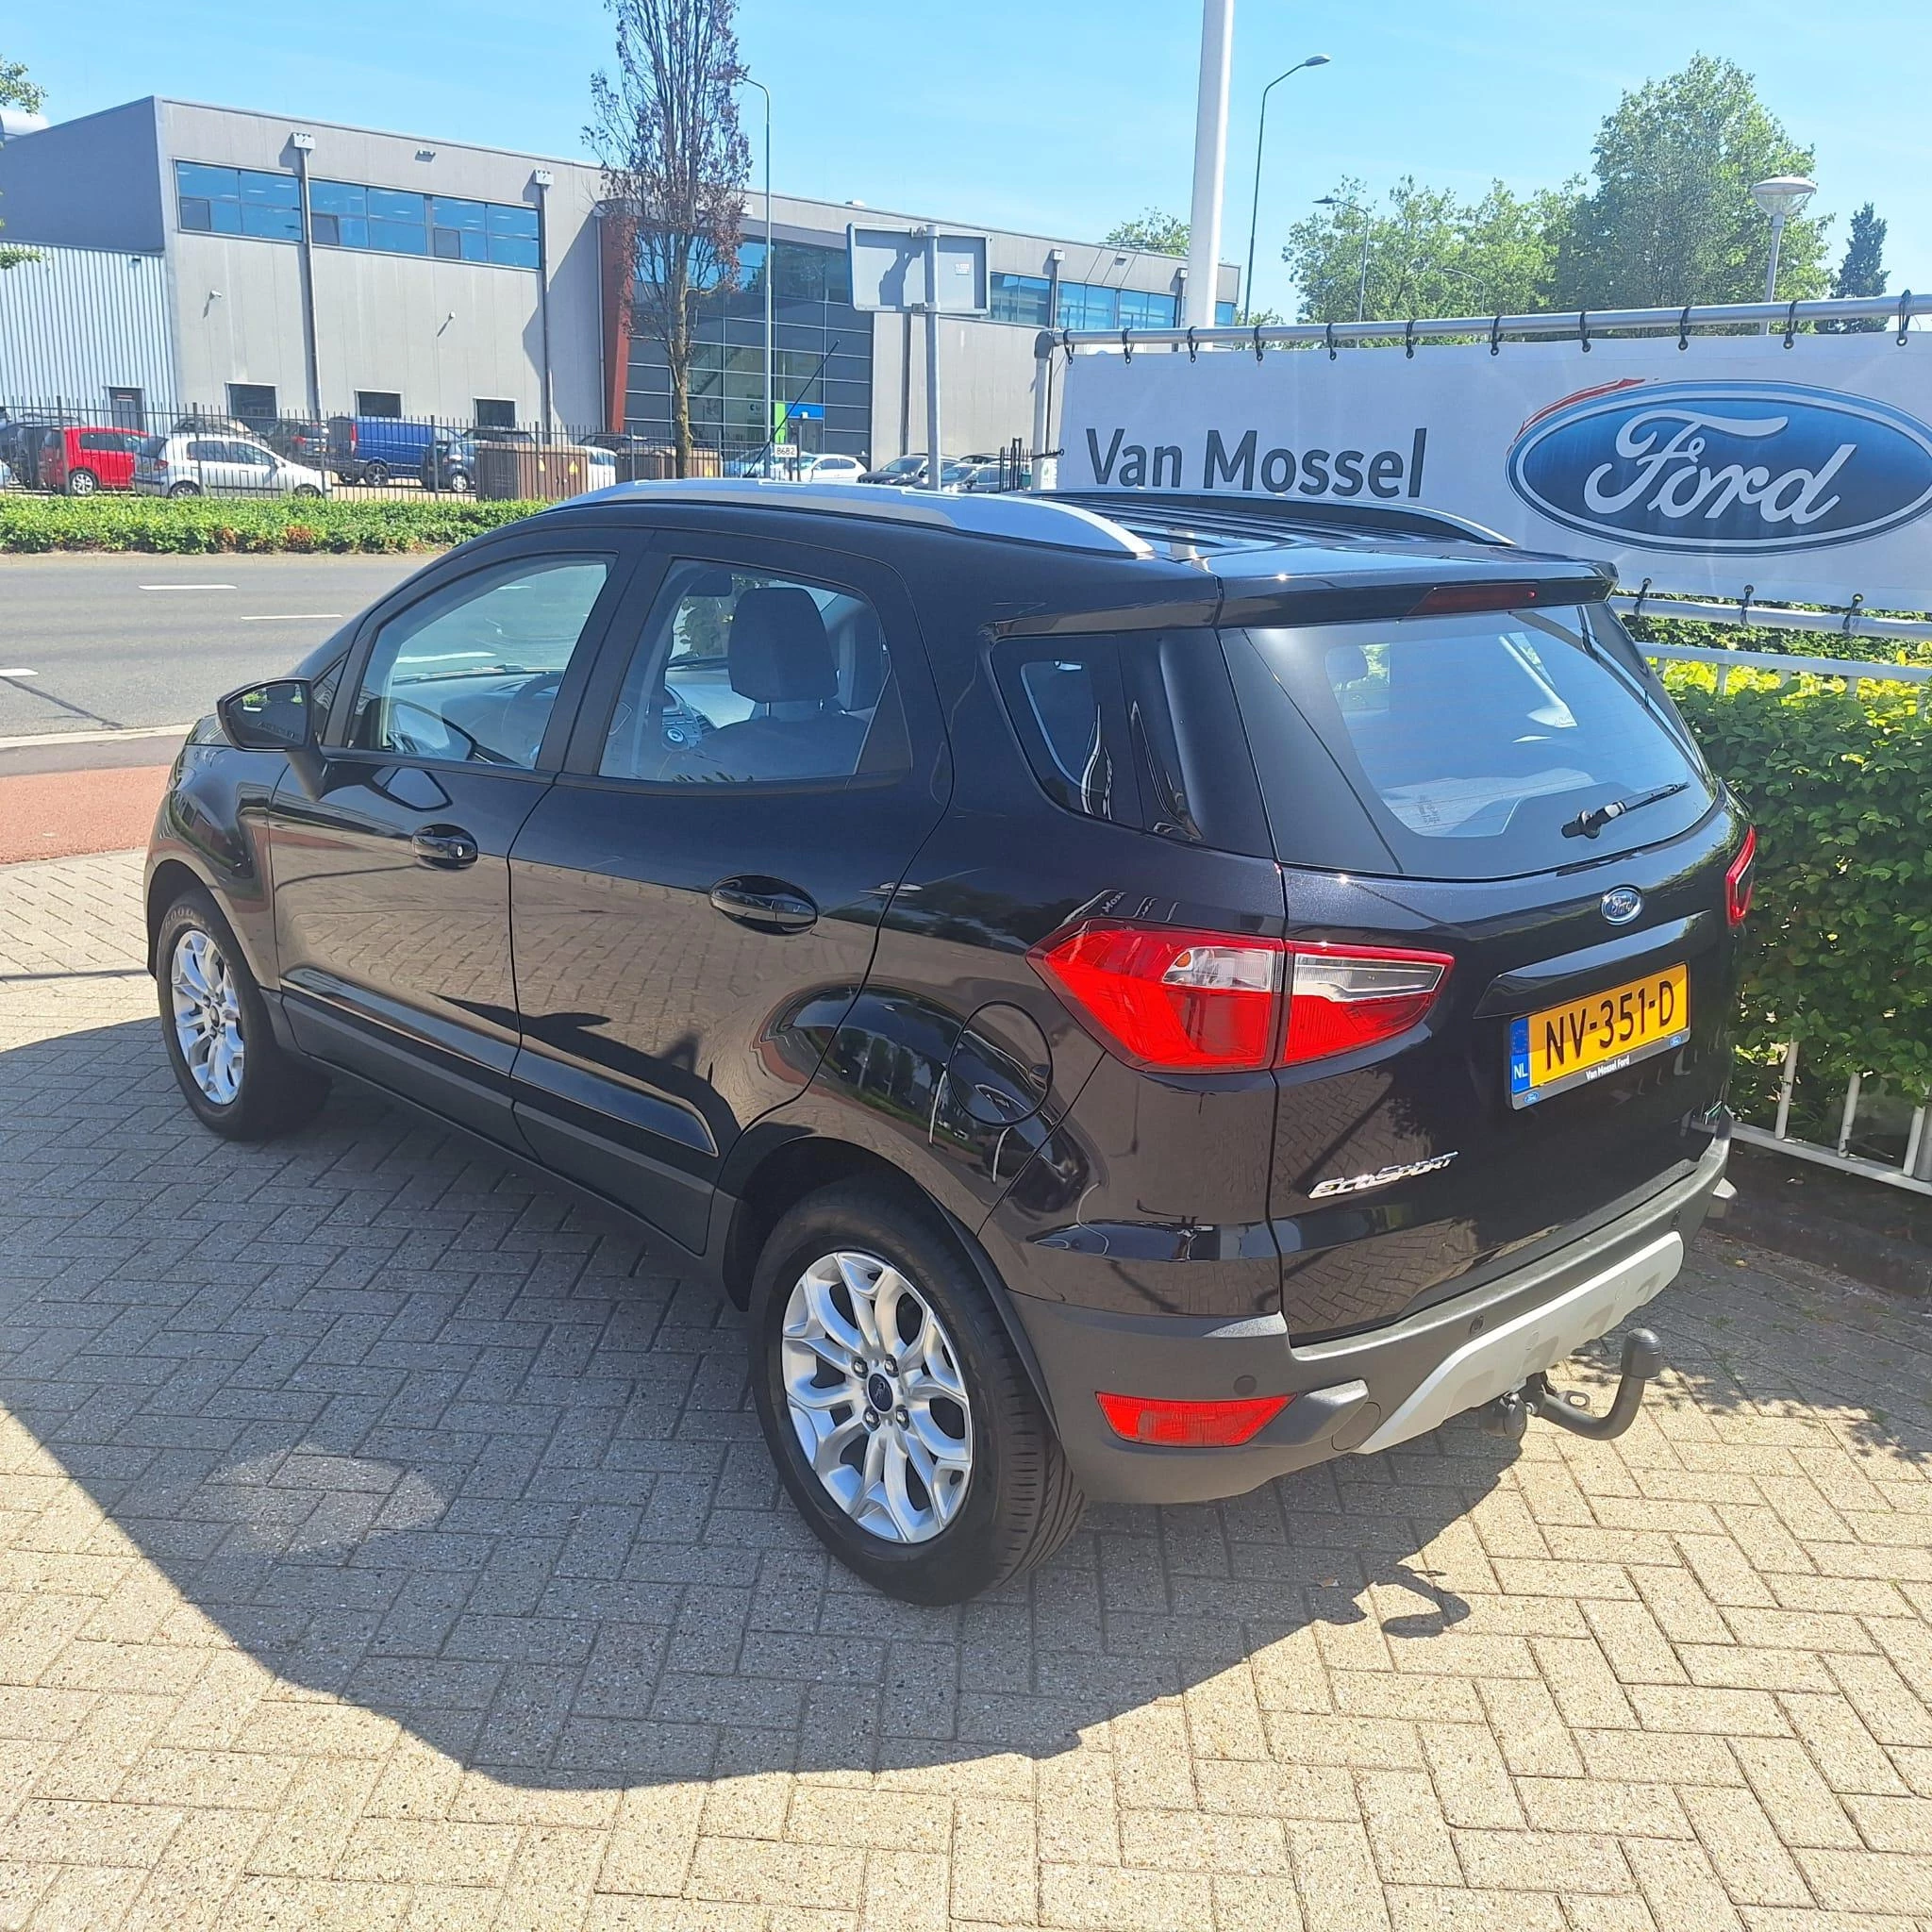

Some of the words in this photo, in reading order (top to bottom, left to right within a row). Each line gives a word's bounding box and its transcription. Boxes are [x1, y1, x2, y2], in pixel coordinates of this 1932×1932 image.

[776, 447, 795, 456] 8682
[1086, 427, 1182, 488] Van
[1203, 427, 1427, 498] Mossel
[1584, 408, 1857, 525] Ford
[1546, 980, 1674, 1071] NV-351-D
[1514, 1062, 1528, 1080] NL
[1586, 1069, 1599, 1081] Van
[1598, 1062, 1617, 1076] Mossel
[1617, 1055, 1630, 1068] Ford
